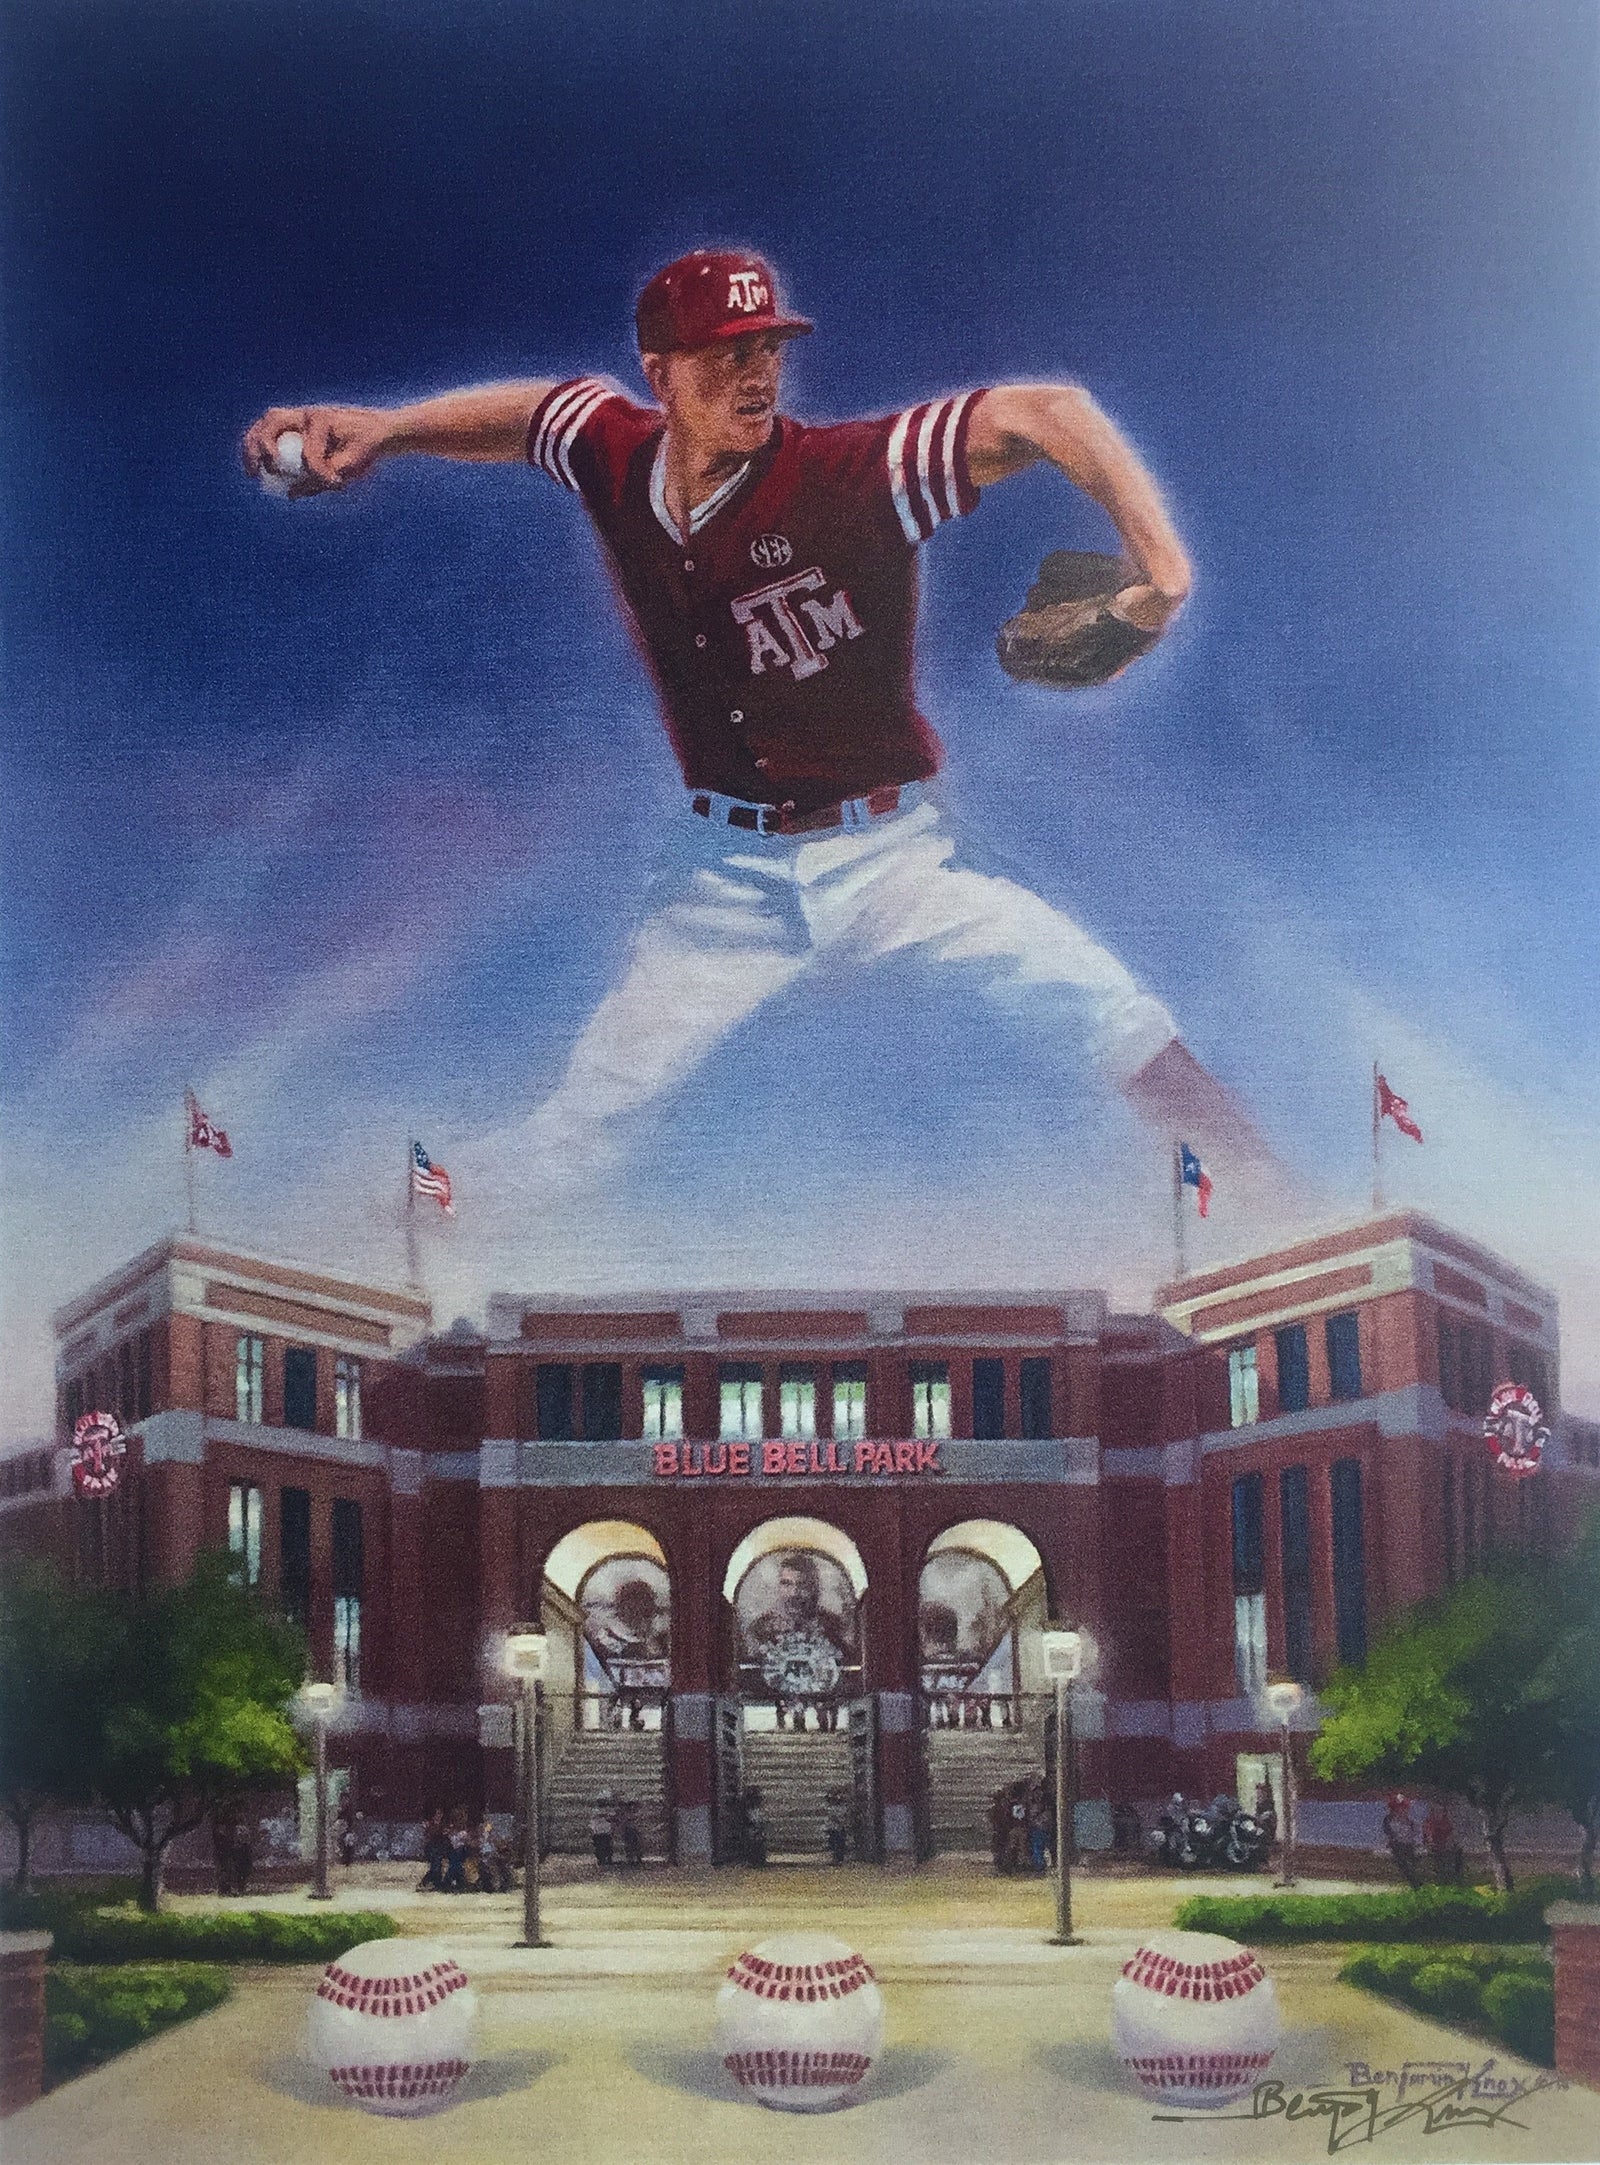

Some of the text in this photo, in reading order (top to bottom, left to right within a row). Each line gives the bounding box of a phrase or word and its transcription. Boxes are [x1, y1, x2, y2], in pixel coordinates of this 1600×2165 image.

[727, 271, 768, 312] ATM
[731, 566, 865, 680] ATM
[654, 1440, 940, 1476] BLUE BELL PARK
